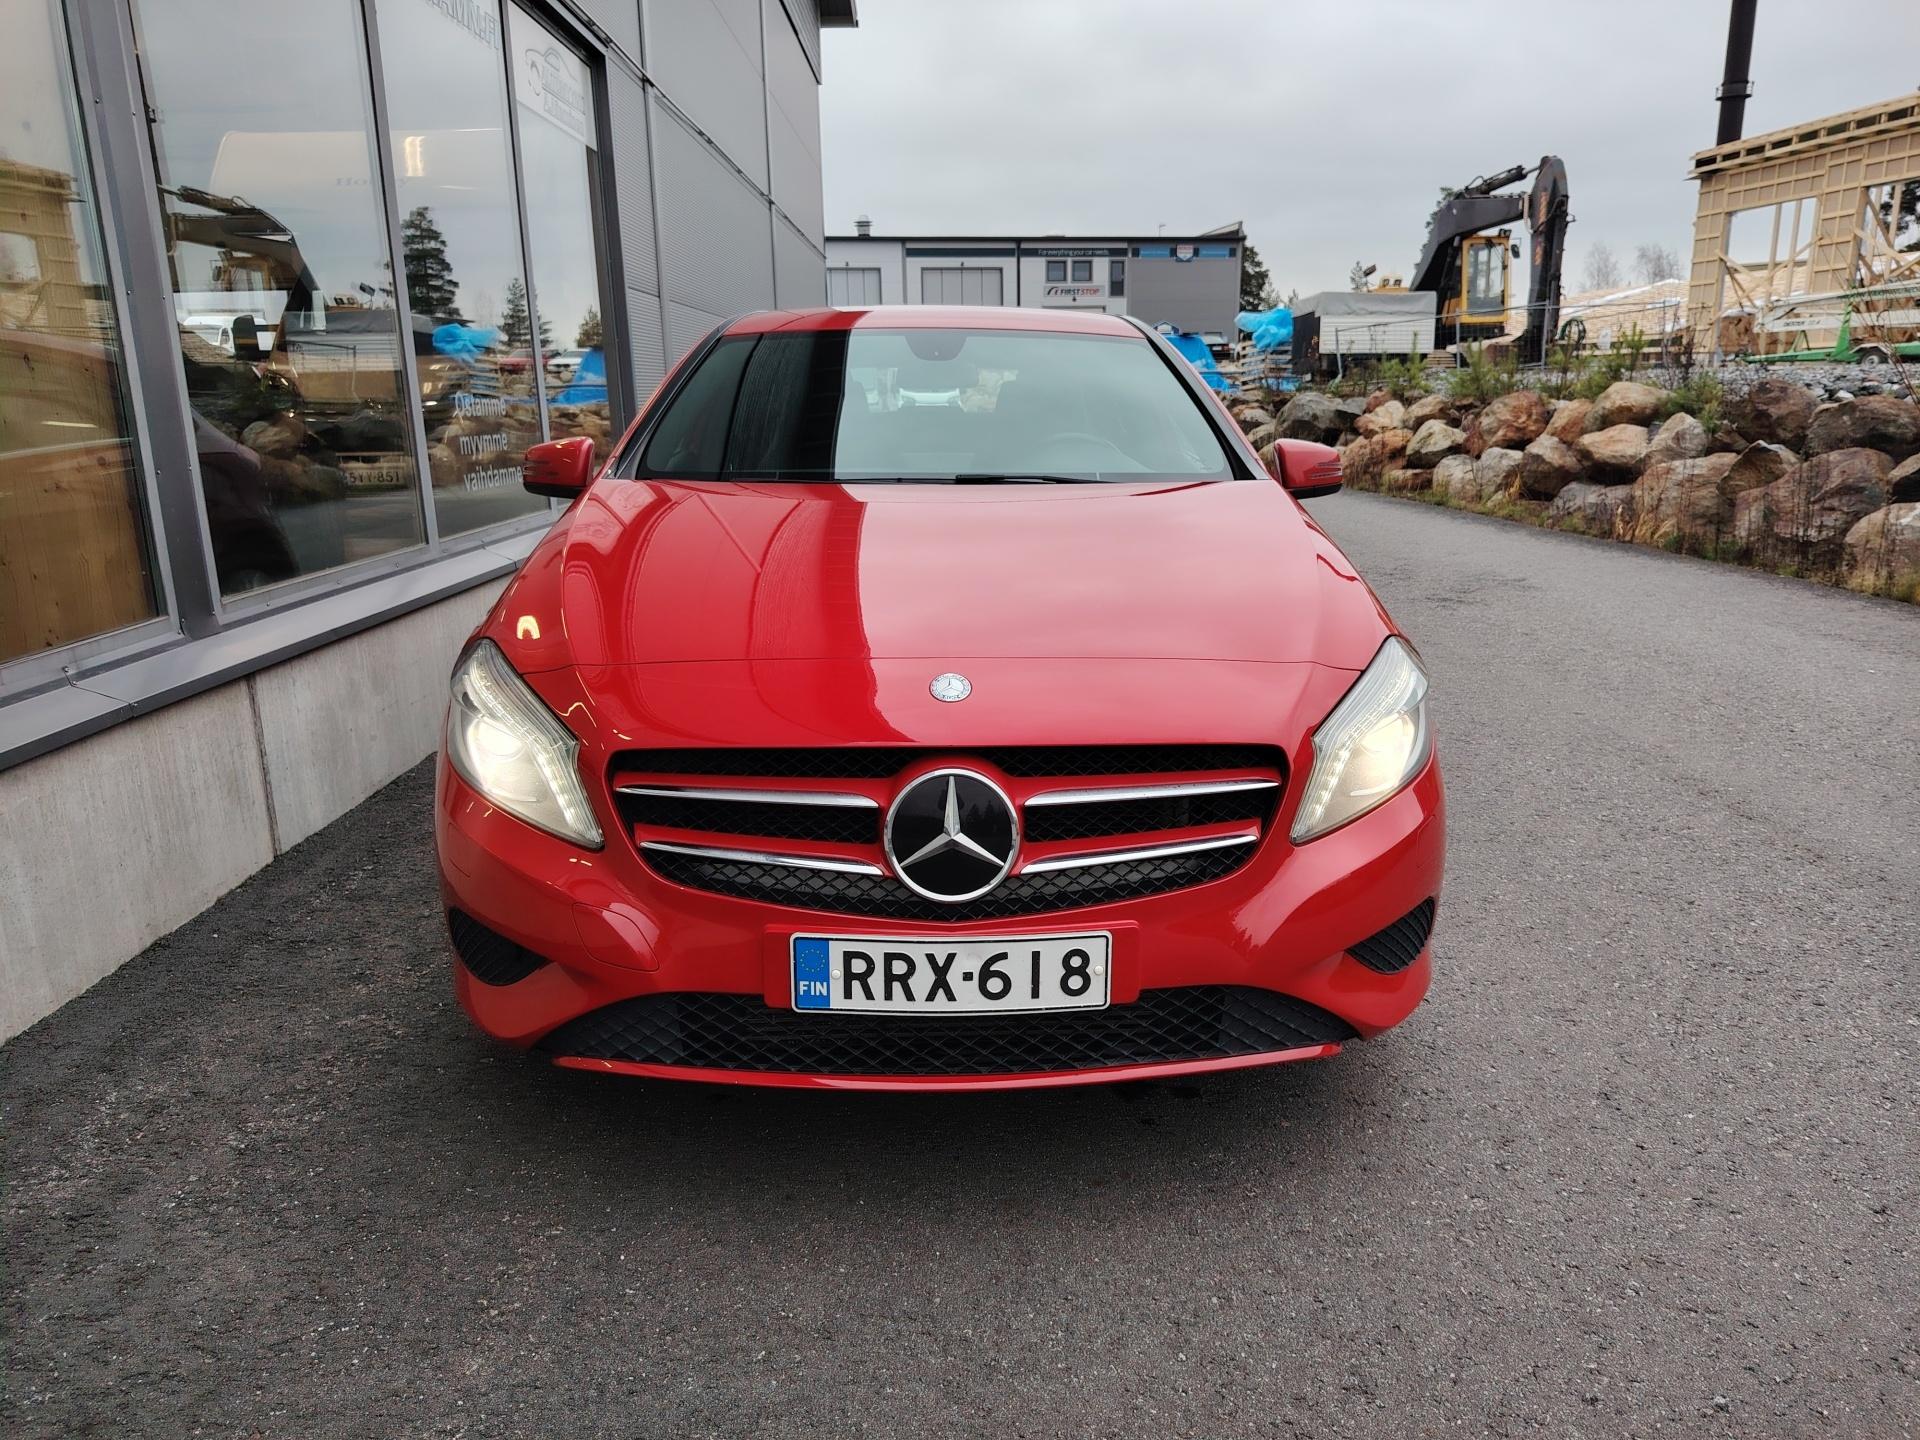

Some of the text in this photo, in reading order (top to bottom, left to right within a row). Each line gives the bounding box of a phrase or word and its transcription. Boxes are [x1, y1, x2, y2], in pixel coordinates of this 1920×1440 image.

[455, 391, 506, 416] Ostamme
[459, 433, 507, 460] myymme
[464, 466, 523, 492] vaihdamme
[842, 948, 1092, 1002] RRX-618
[800, 981, 828, 996] FIN
